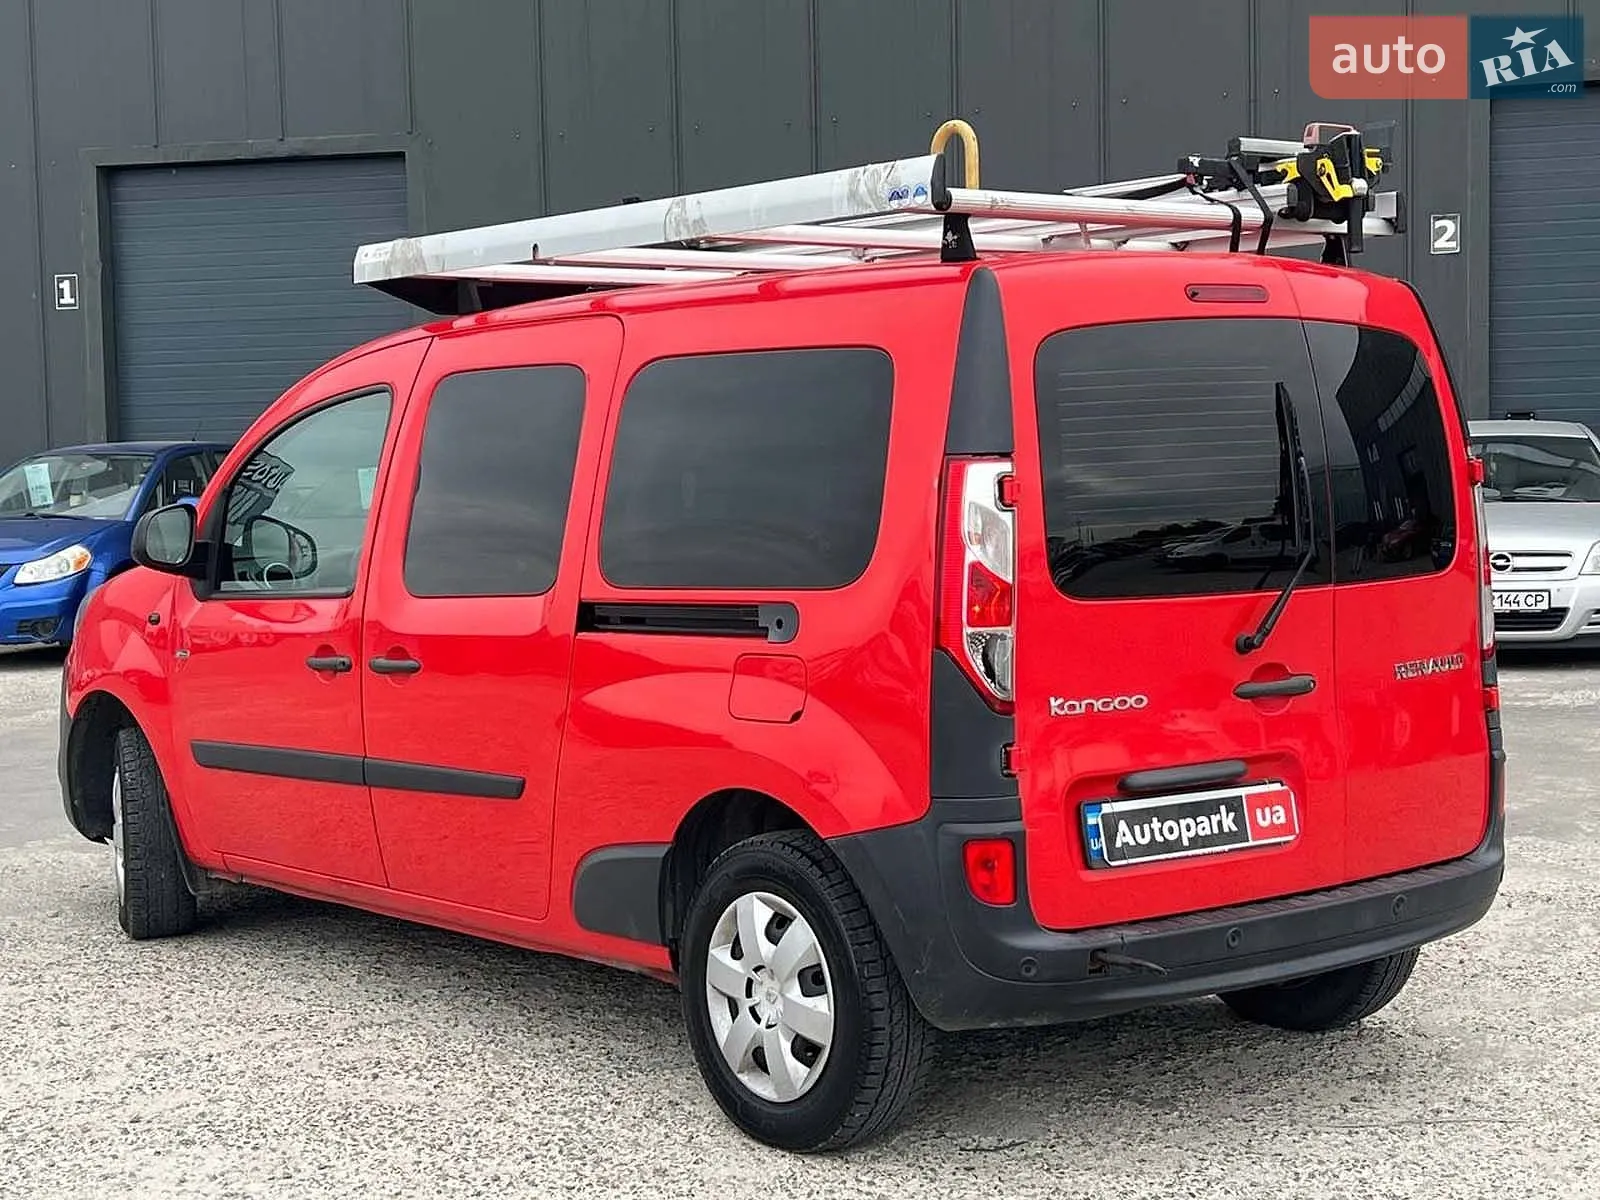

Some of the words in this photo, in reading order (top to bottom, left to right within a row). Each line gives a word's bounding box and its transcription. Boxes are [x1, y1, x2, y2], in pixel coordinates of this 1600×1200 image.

[1434, 219, 1457, 249] 2
[58, 279, 75, 305] 1
[1524, 594, 1545, 607] CP
[1393, 653, 1465, 680] RENAULT
[1114, 804, 1239, 849] Autopark
[1255, 804, 1288, 828] ua
